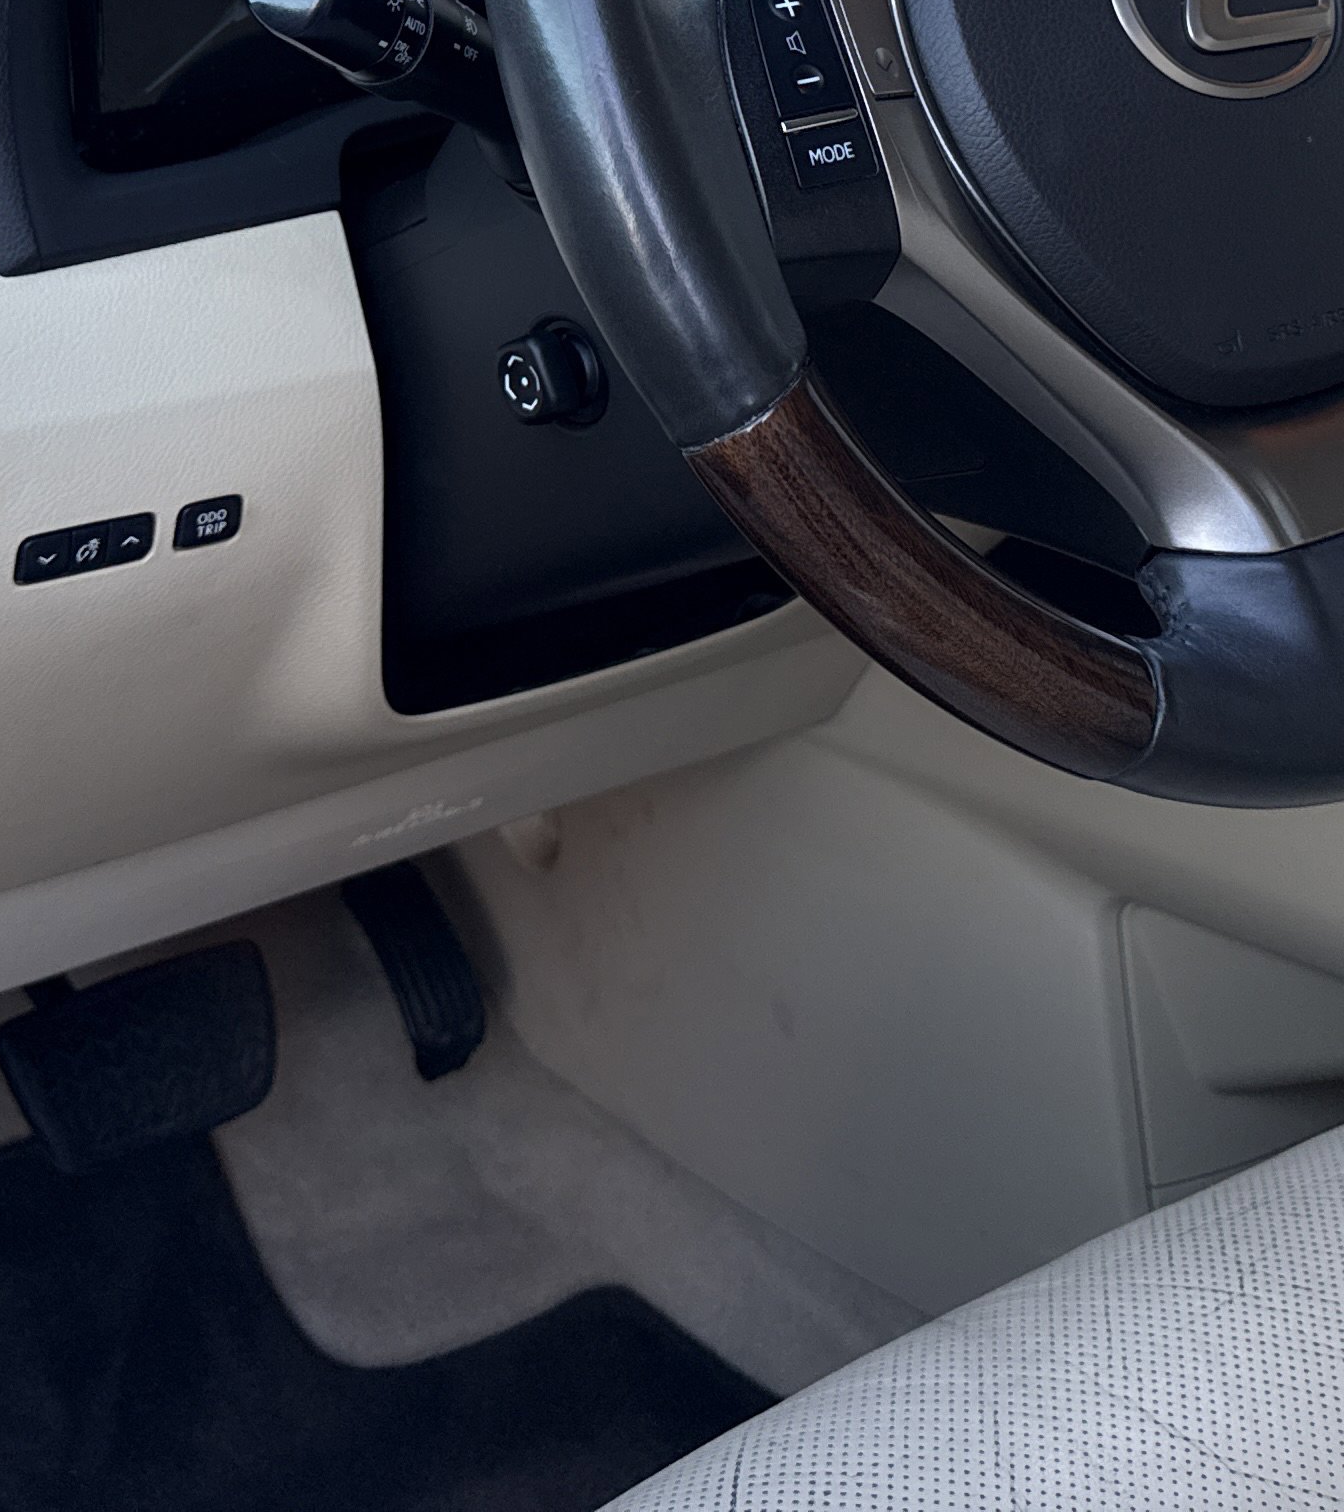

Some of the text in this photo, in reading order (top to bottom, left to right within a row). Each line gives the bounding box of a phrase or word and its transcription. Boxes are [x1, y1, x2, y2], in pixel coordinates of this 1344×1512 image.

[405, 16, 425, 35] AUTO
[395, 50, 413, 65] OFF
[464, 45, 479, 62] OFF
[809, 141, 856, 167] MODE
[197, 508, 228, 525] ODO
[197, 521, 228, 538] TRIP
